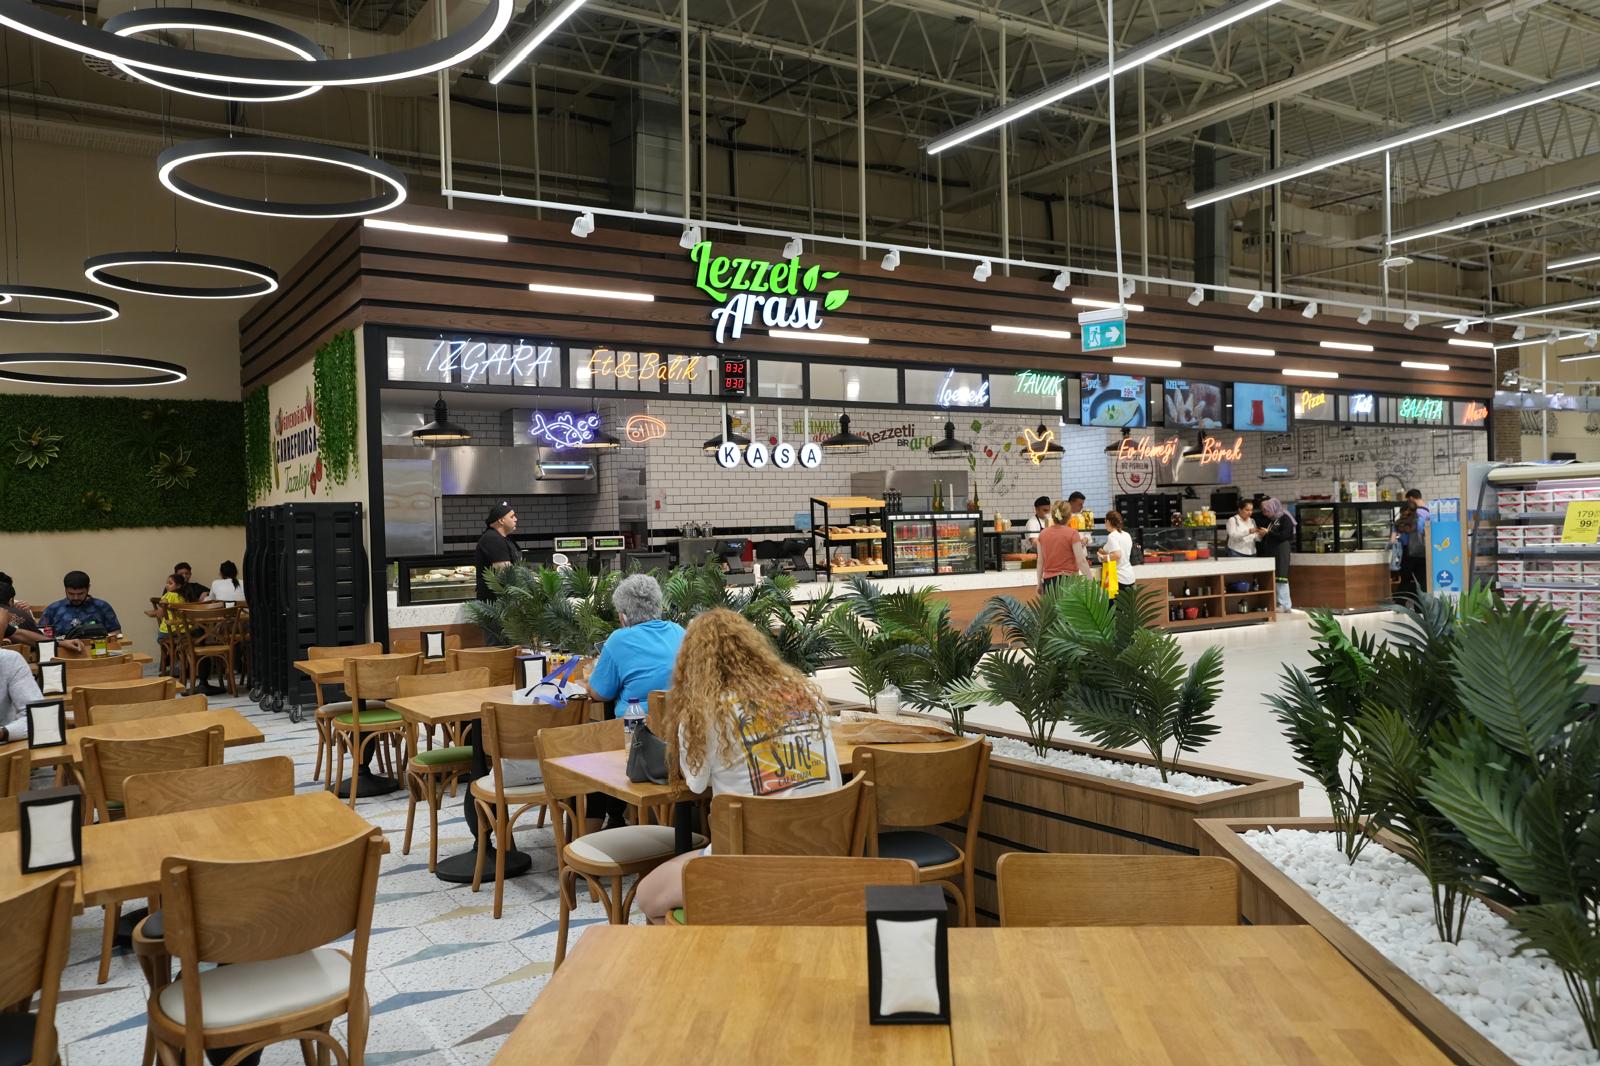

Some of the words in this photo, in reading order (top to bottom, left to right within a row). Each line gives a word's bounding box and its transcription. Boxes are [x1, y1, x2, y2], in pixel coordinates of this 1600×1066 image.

[690, 240, 801, 303] Lezzet
[711, 293, 823, 344] Arası
[587, 349, 614, 376] Et
[615, 352, 639, 379] &
[725, 363, 744, 373] 832
[725, 378, 744, 388] 830
[1016, 370, 1065, 395] TAVUK
[1301, 390, 1326, 414] Pizza
[1400, 397, 1443, 420] SALATA
[276, 425, 318, 464] CARREFOURSA
[1200, 437, 1243, 464] Börek
[1579, 520, 1592, 528] 99
[770, 734, 812, 778] SURF
